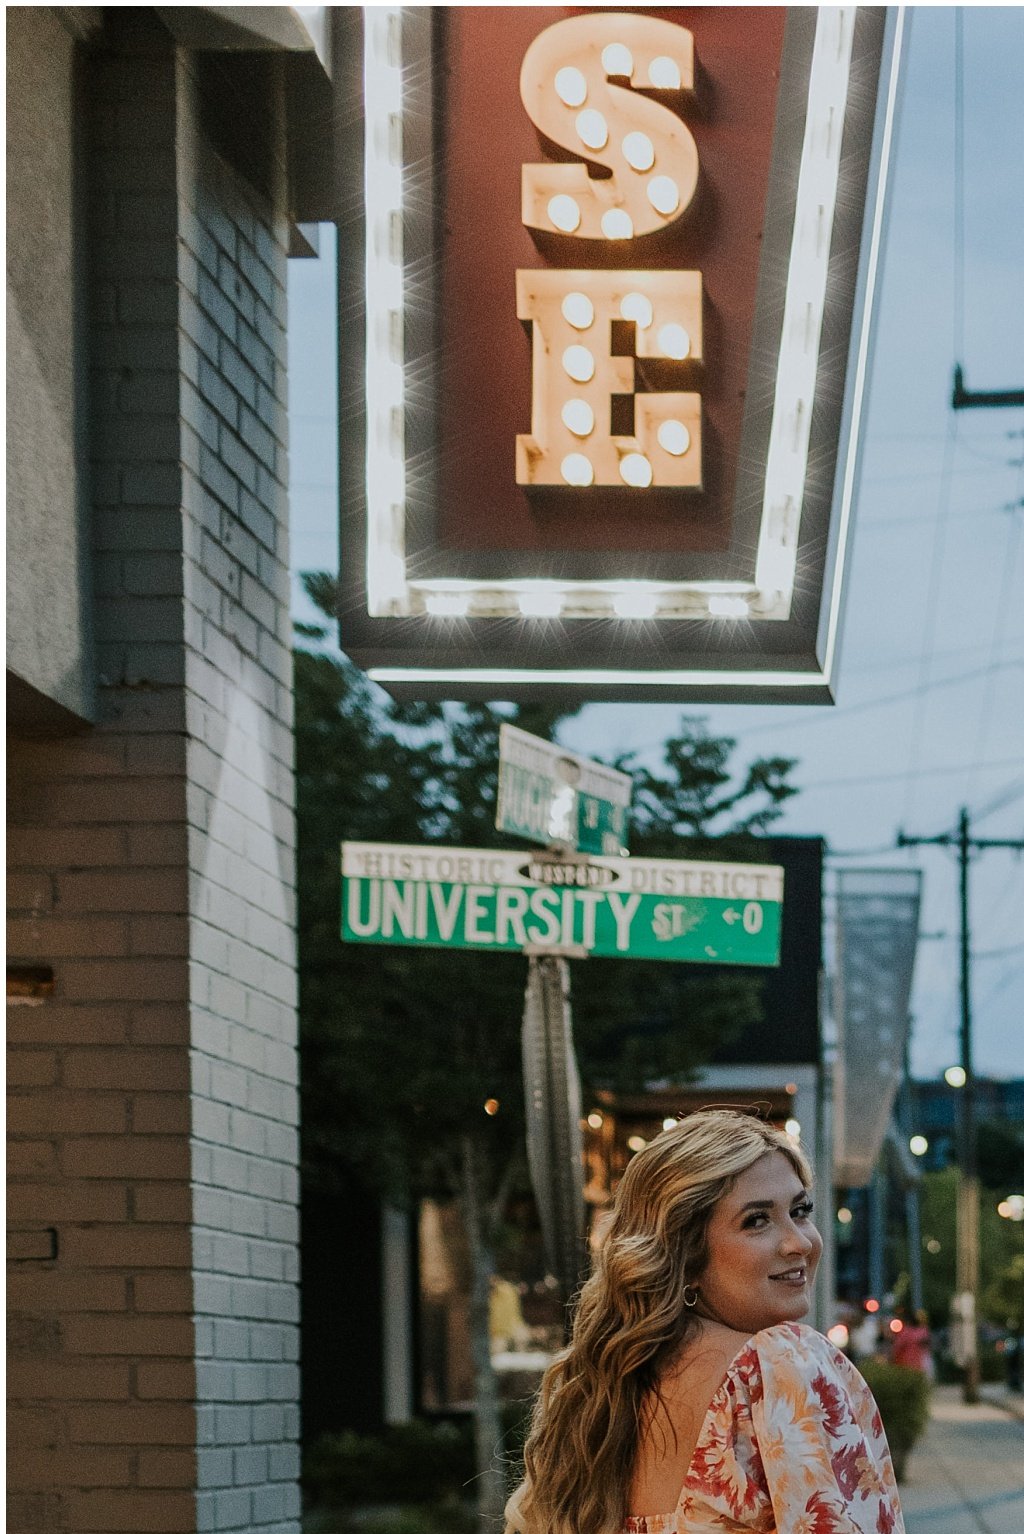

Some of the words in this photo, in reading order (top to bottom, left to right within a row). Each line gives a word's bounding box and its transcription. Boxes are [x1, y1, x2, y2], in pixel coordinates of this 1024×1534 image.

[359, 852, 505, 883] HISTORIC
[630, 866, 769, 898] DISTRICT
[347, 878, 642, 951] UNIVERSITY
